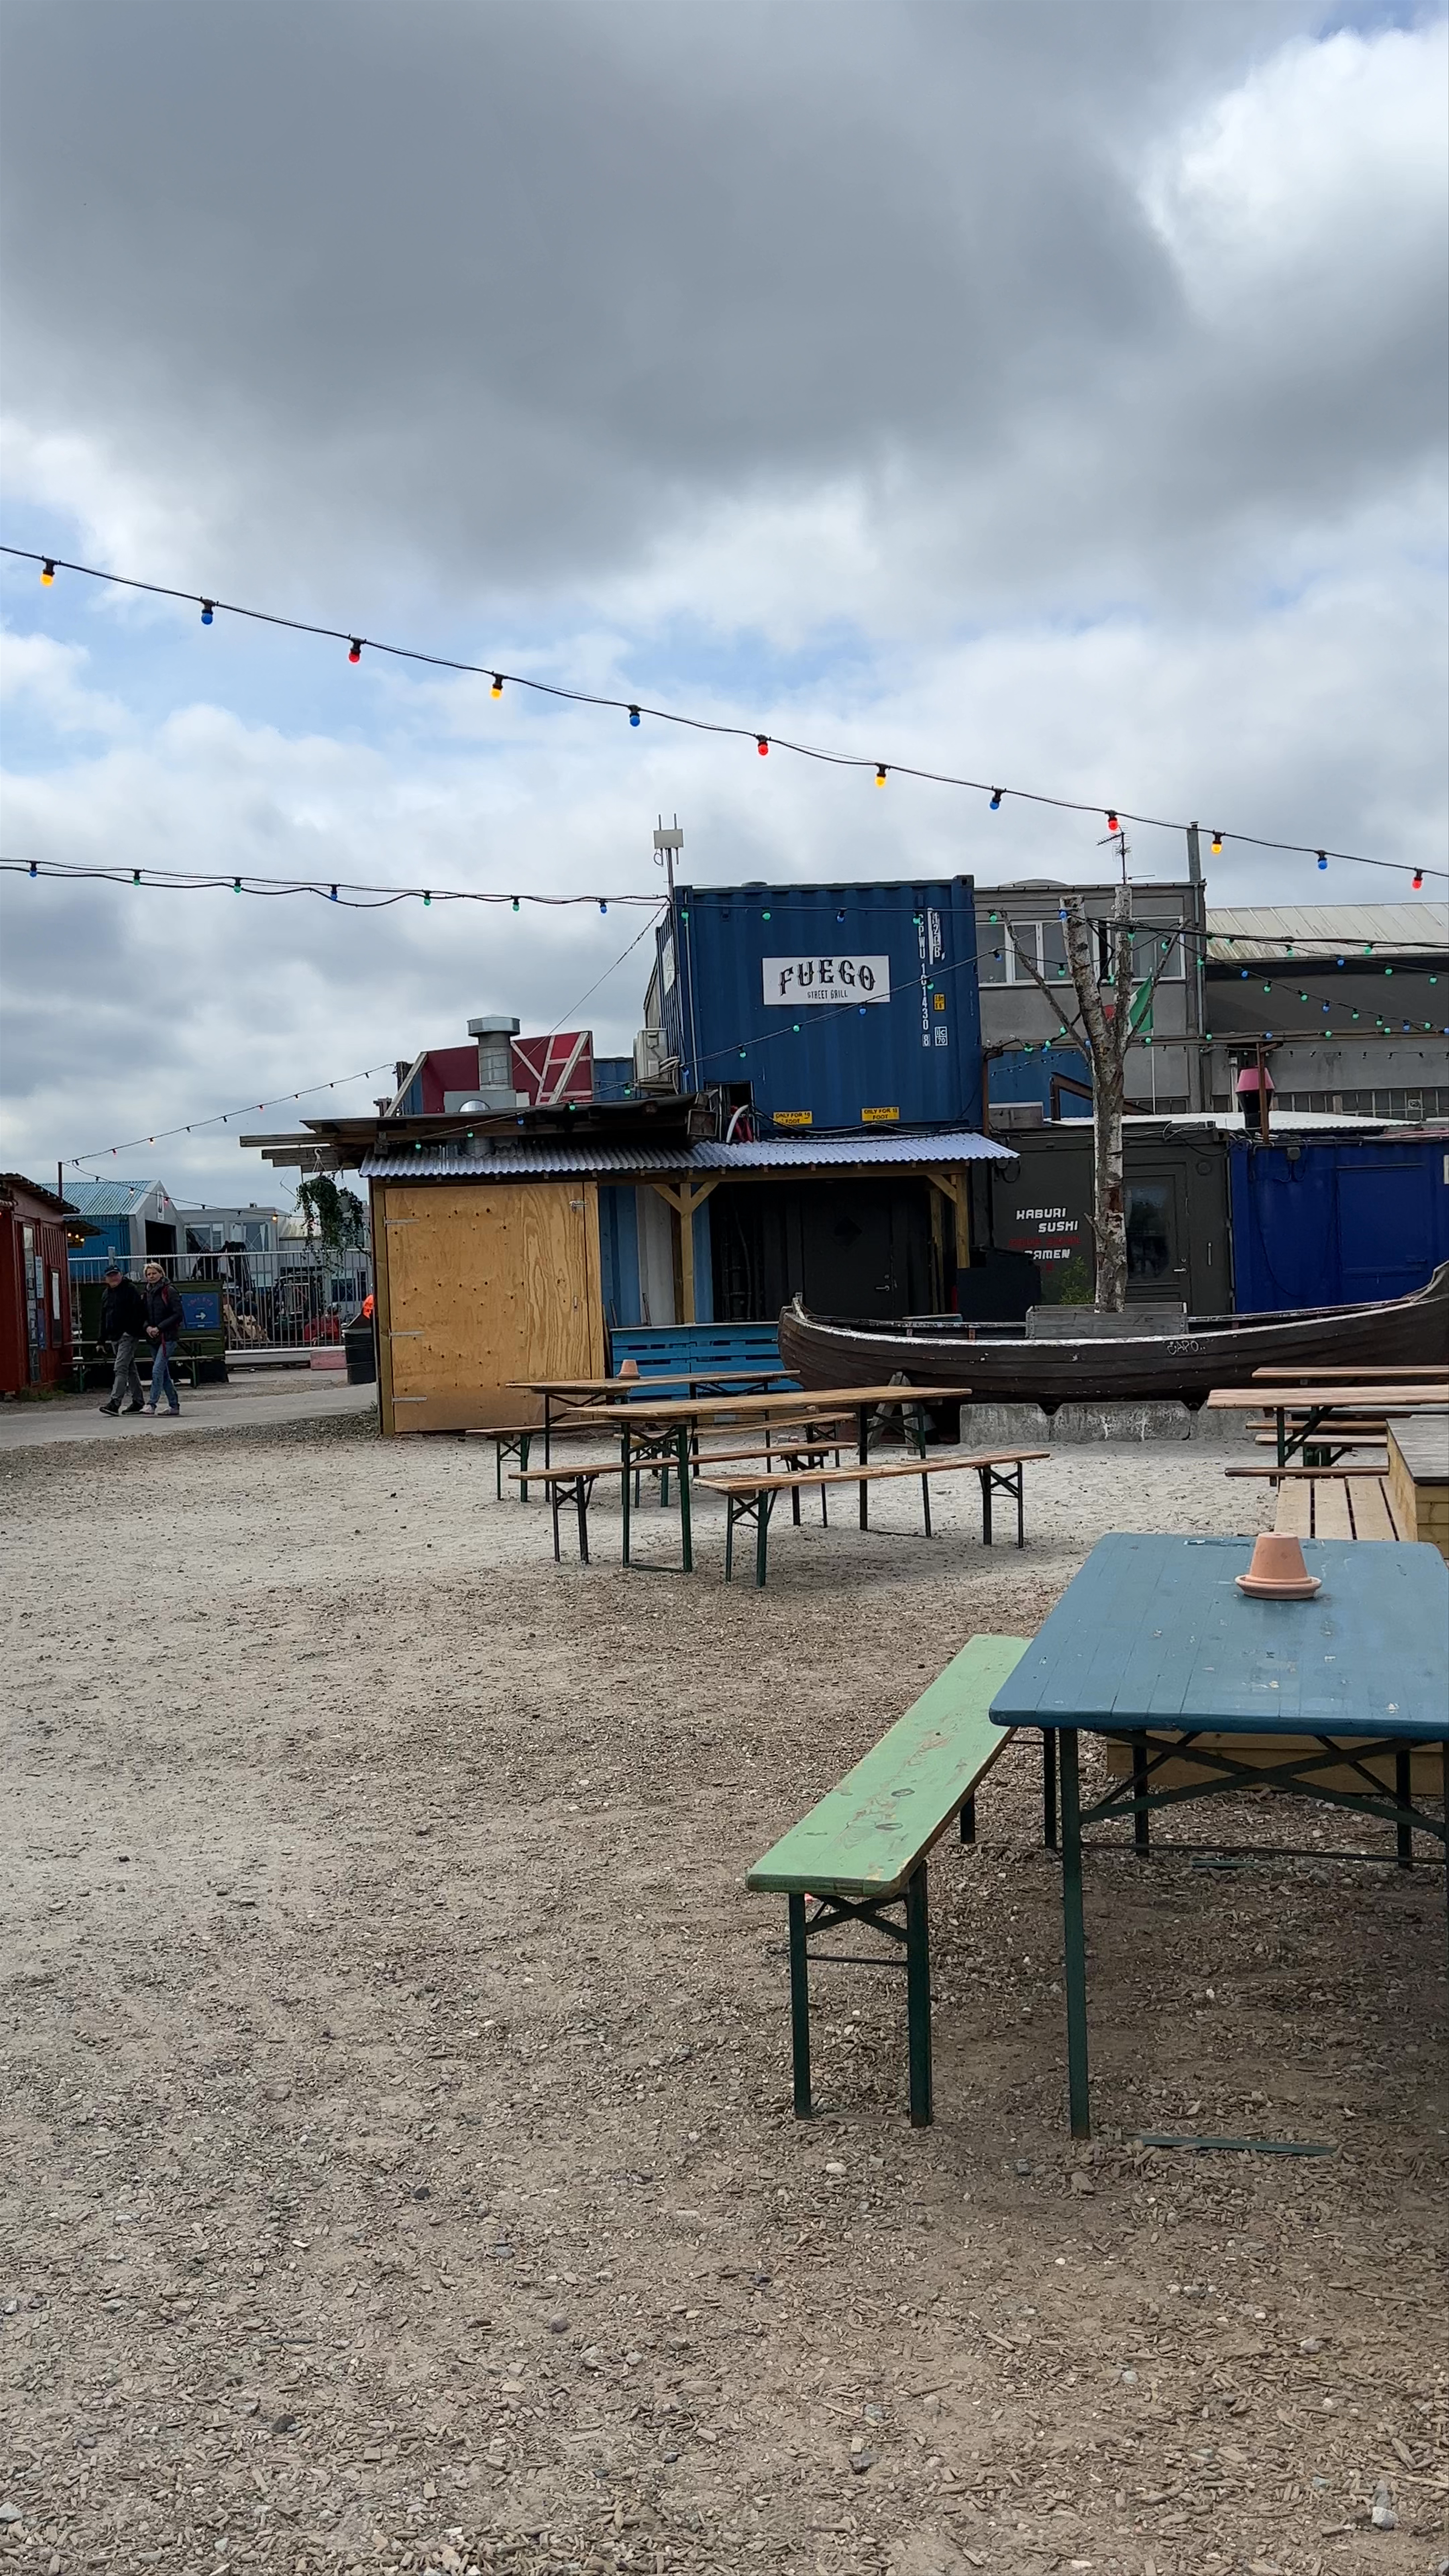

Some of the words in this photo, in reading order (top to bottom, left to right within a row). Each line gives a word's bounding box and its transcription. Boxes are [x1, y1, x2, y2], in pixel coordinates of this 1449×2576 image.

[779, 959, 876, 996] FUEGO
[807, 990, 828, 999] STREET
[831, 989, 848, 999] GRILL
[1016, 1207, 1066, 1220] KABURI
[1038, 1220, 1078, 1233] SUSHI
